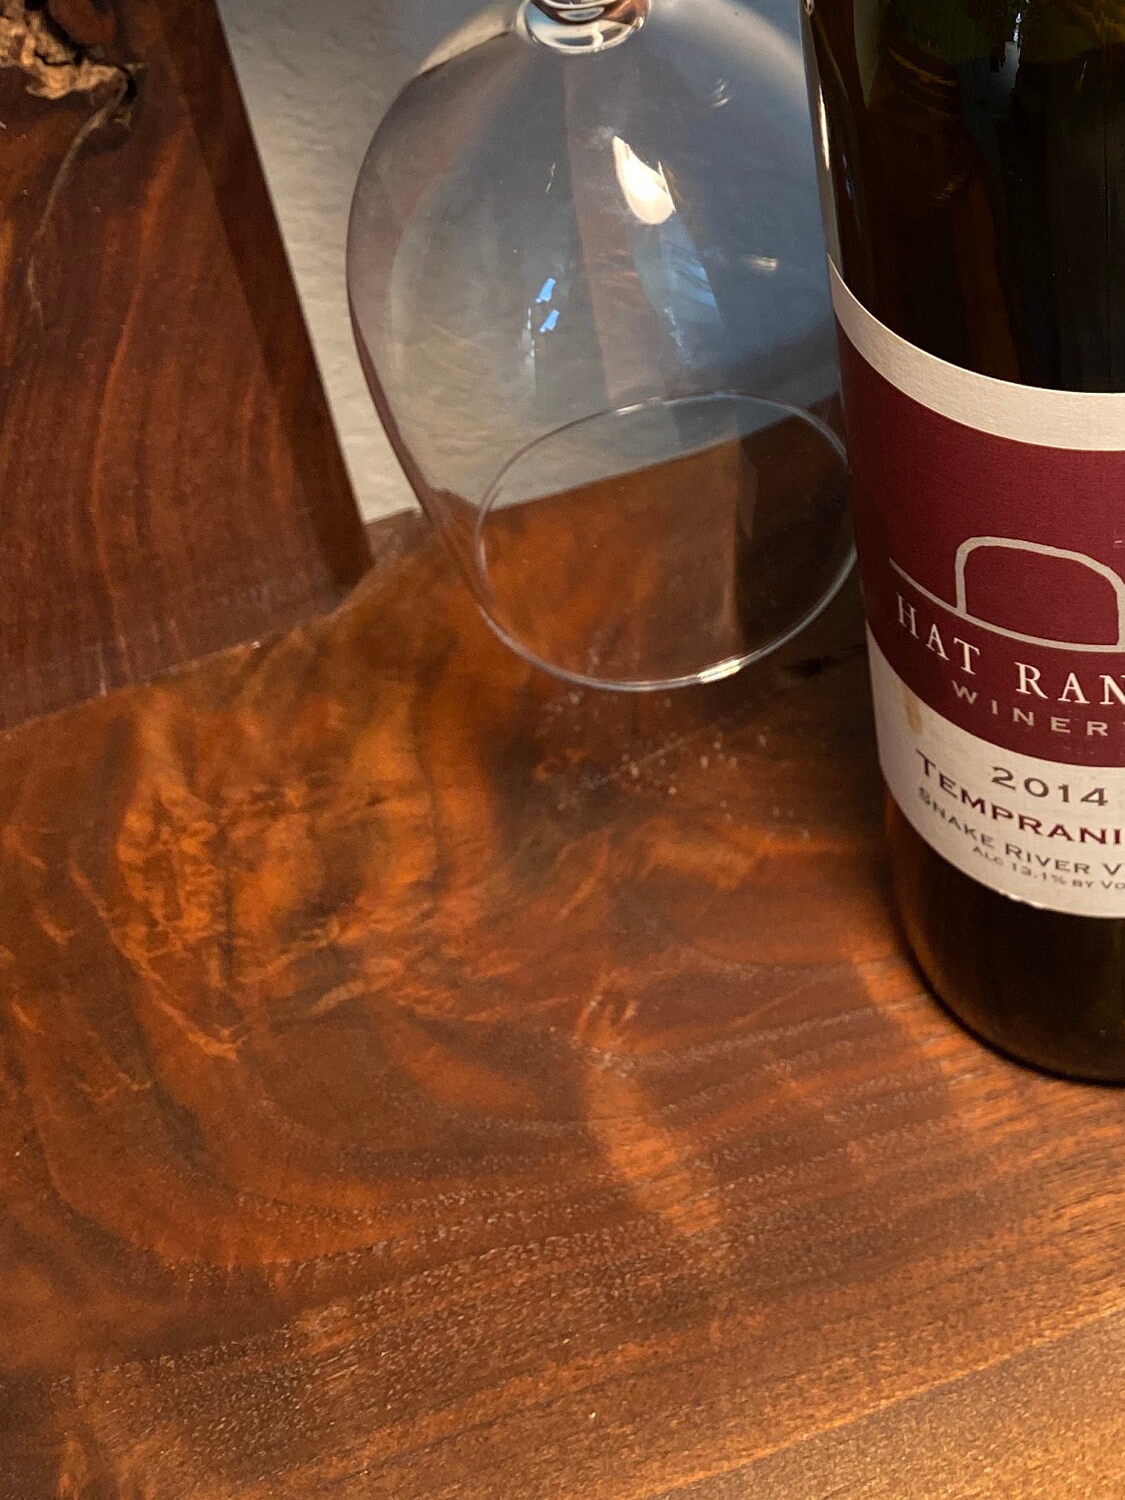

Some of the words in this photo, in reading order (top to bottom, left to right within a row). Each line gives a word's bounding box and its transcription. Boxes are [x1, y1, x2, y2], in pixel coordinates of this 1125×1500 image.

[896, 592, 981, 675] HAT
[991, 766, 1109, 807] 2014
[918, 786, 996, 850] SNAKE
[1004, 842, 1092, 876] RIVER
[1071, 879, 1095, 889] BY
